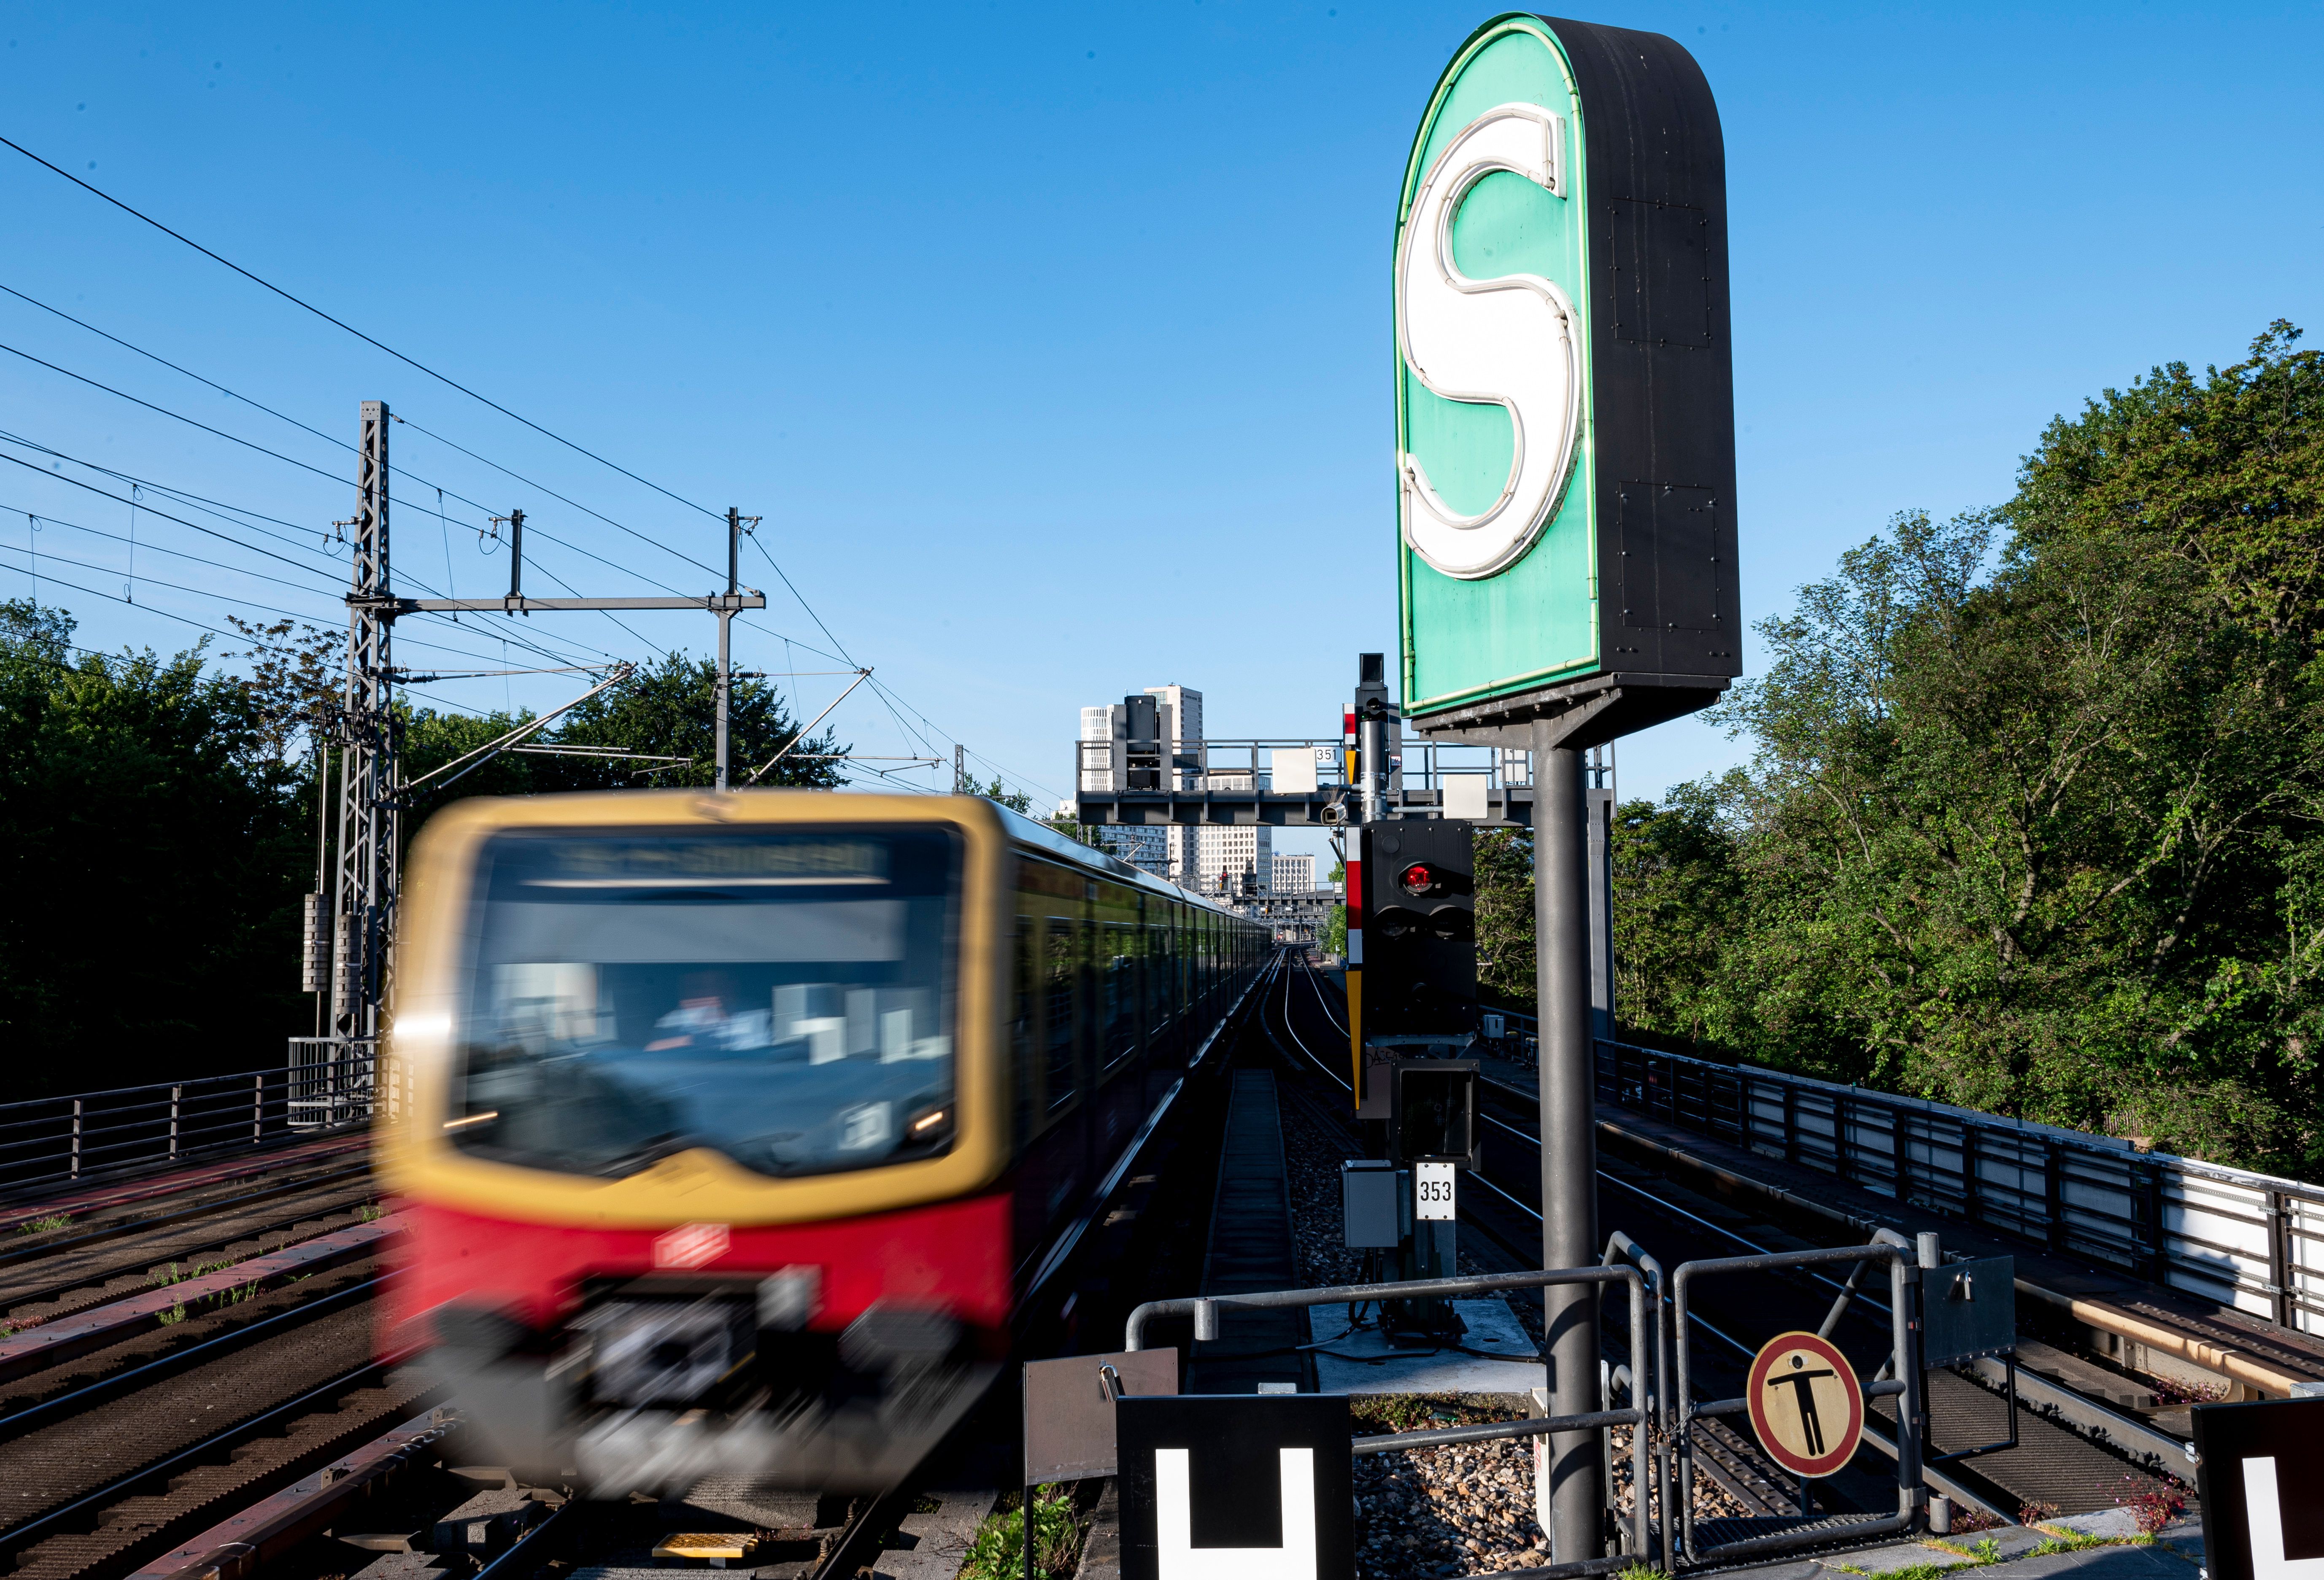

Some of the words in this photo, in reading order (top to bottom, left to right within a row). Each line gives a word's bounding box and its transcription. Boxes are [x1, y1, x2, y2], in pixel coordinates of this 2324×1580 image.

[1396, 102, 1583, 581] S
[1317, 749, 1336, 760] 351
[1420, 1181, 1451, 1201] 353
